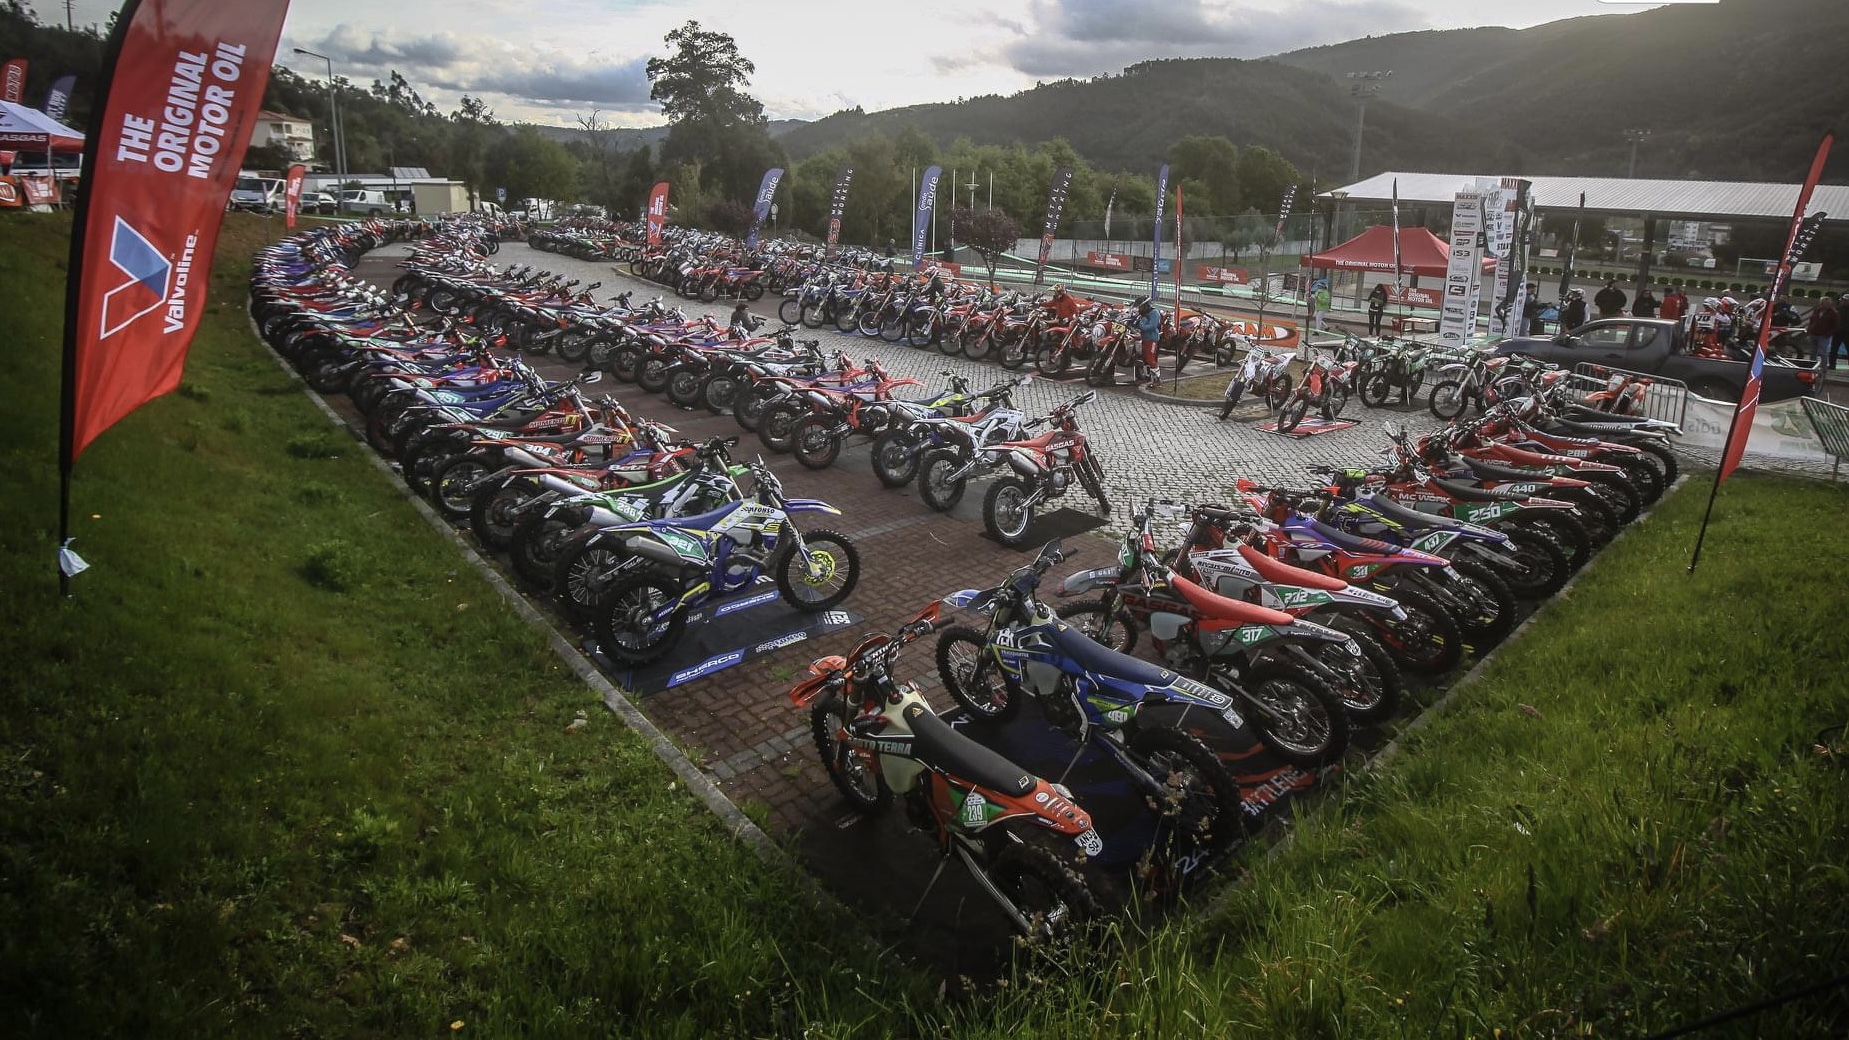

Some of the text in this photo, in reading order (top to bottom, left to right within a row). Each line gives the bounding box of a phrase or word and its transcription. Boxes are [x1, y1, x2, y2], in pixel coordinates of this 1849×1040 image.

[153, 51, 208, 173] ORIGINAL
[187, 42, 247, 179] MOTOR OIL
[0, 134, 48, 142] ASGAS
[117, 113, 155, 163] THE
[163, 234, 198, 334] Valvoline
[524, 443, 552, 456] 304
[1045, 439, 1075, 452] GASGAS
[608, 464, 648, 472] Beta
[1513, 485, 1536, 493] 440
[1399, 493, 1451, 503] MC WORK
[1468, 506, 1501, 523] 250
[1424, 536, 1440, 550] 437
[1241, 629, 1262, 642] 317
[675, 653, 740, 679] SHERCO
[877, 741, 912, 755] TERRA
[967, 804, 983, 821] 239
